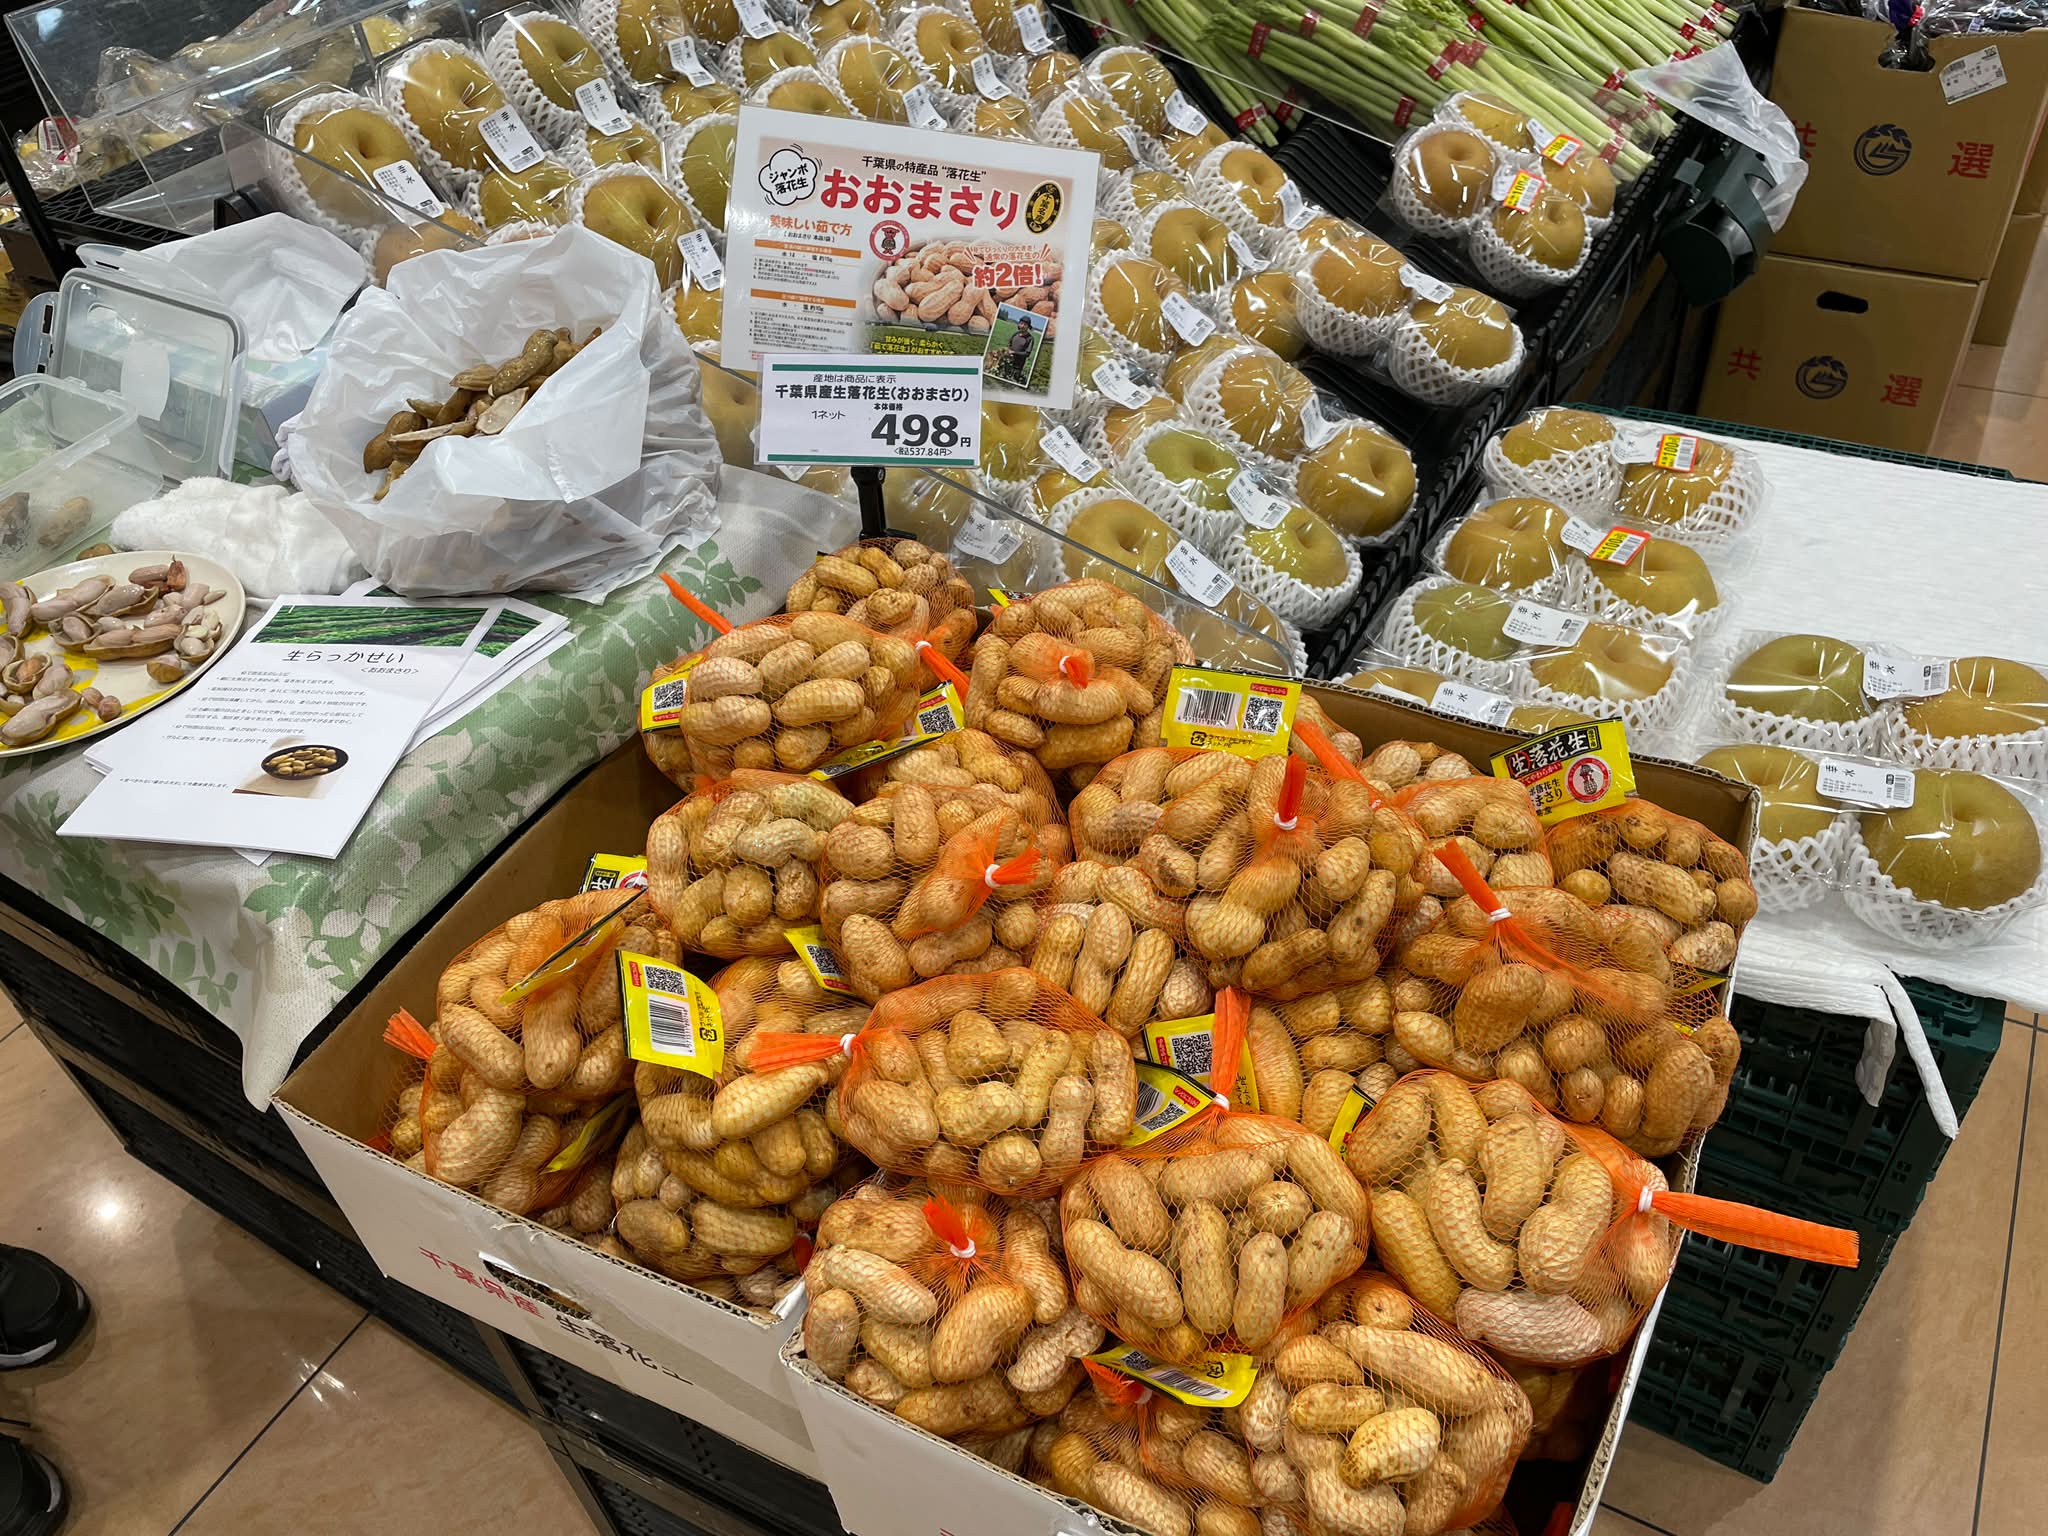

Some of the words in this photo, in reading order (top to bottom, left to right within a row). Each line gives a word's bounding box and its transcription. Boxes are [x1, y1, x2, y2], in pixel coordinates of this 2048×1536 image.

[1948, 142, 1994, 179] 選
[769, 163, 809, 183] ジャンボ
[775, 176, 809, 195] 落花生
[820, 168, 1020, 231] おおまさり
[769, 215, 853, 237] 美味しい茹で方
[973, 262, 1043, 289] 約2倍!
[813, 374, 897, 384] 産地は商品に表示
[1727, 347, 1761, 380] 共
[1881, 374, 1923, 408] 選
[811, 410, 846, 420] 1ネット
[281, 649, 405, 665] 生らっかせい
[1512, 731, 1589, 777] 生落花生
[1531, 787, 1563, 808] まさり
